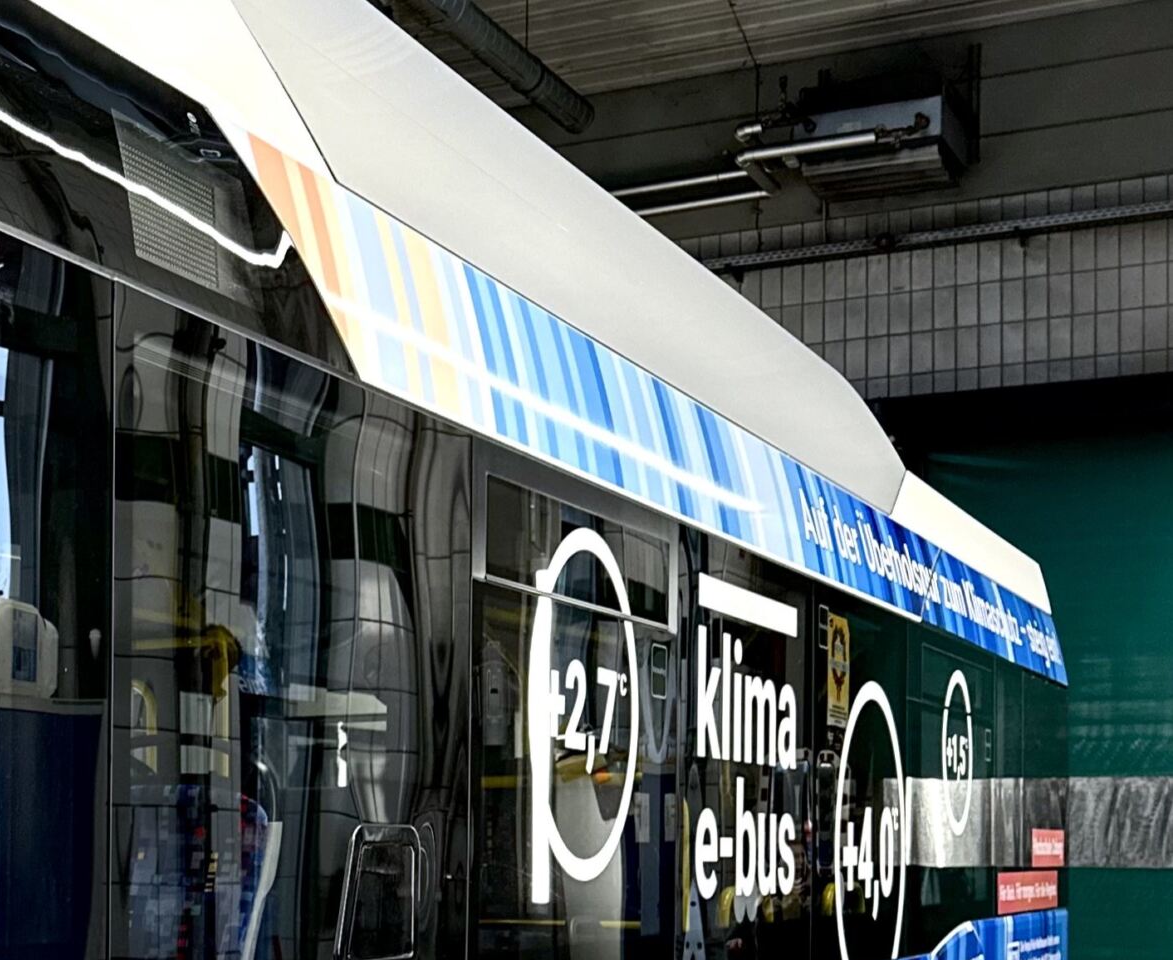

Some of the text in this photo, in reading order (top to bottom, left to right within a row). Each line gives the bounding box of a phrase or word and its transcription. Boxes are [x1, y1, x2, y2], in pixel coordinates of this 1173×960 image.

[799, 487, 834, 553] Auf
[832, 504, 862, 566] der
[696, 624, 797, 770] klima
[694, 776, 796, 900] e-bus
